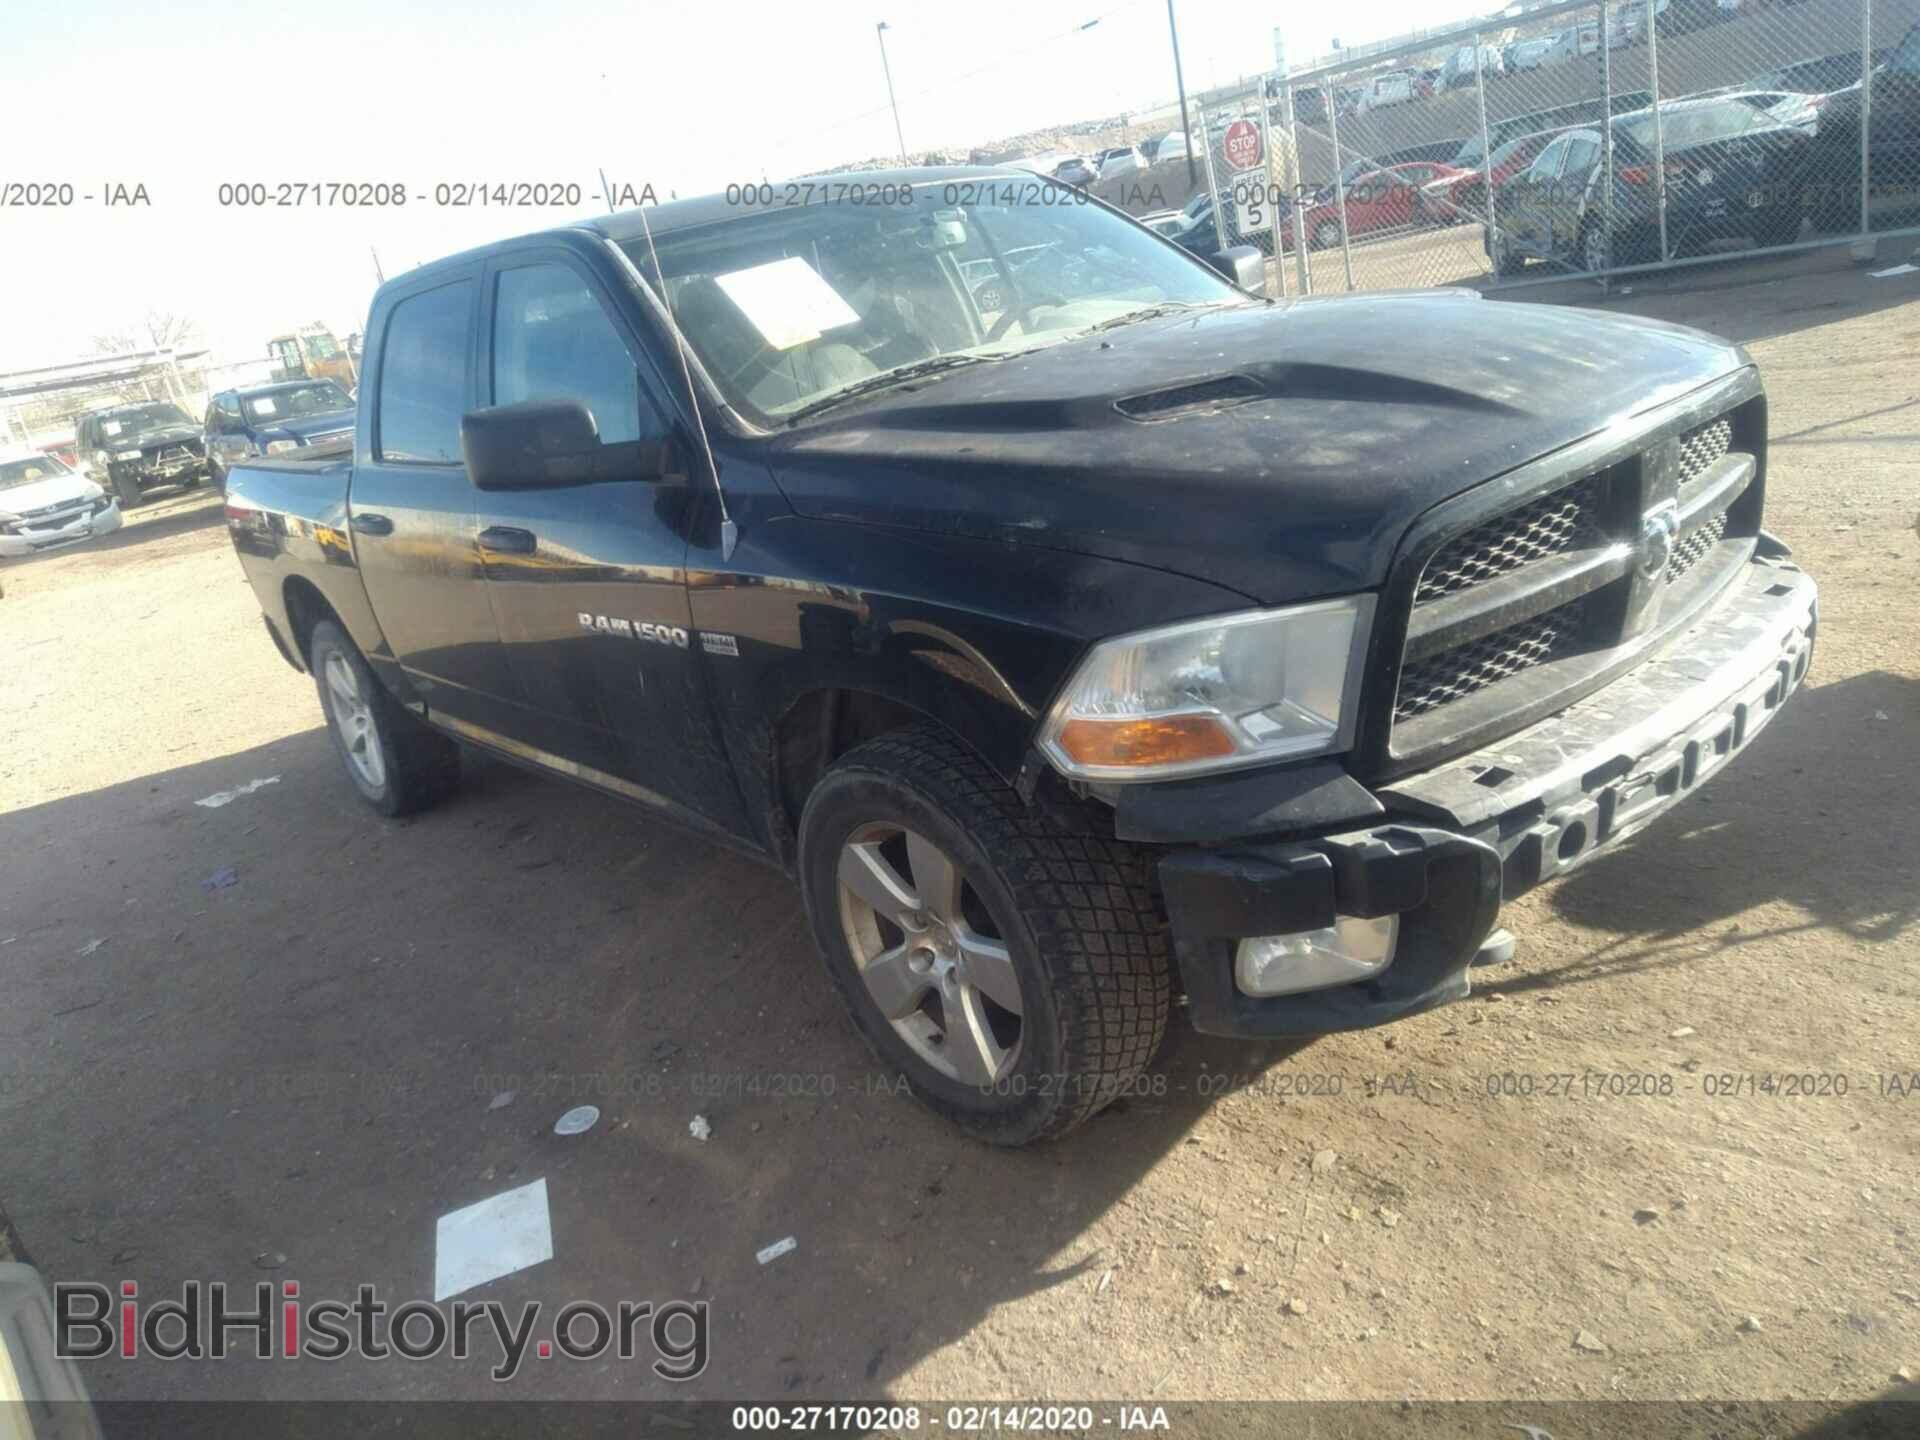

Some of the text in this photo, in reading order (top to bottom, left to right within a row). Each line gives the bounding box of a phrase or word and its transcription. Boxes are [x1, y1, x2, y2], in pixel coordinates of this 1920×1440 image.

[1230, 135, 1256, 153] STOP
[1248, 204, 1263, 226] 5
[577, 612, 633, 640] RAM
[632, 620, 690, 651] 1500
